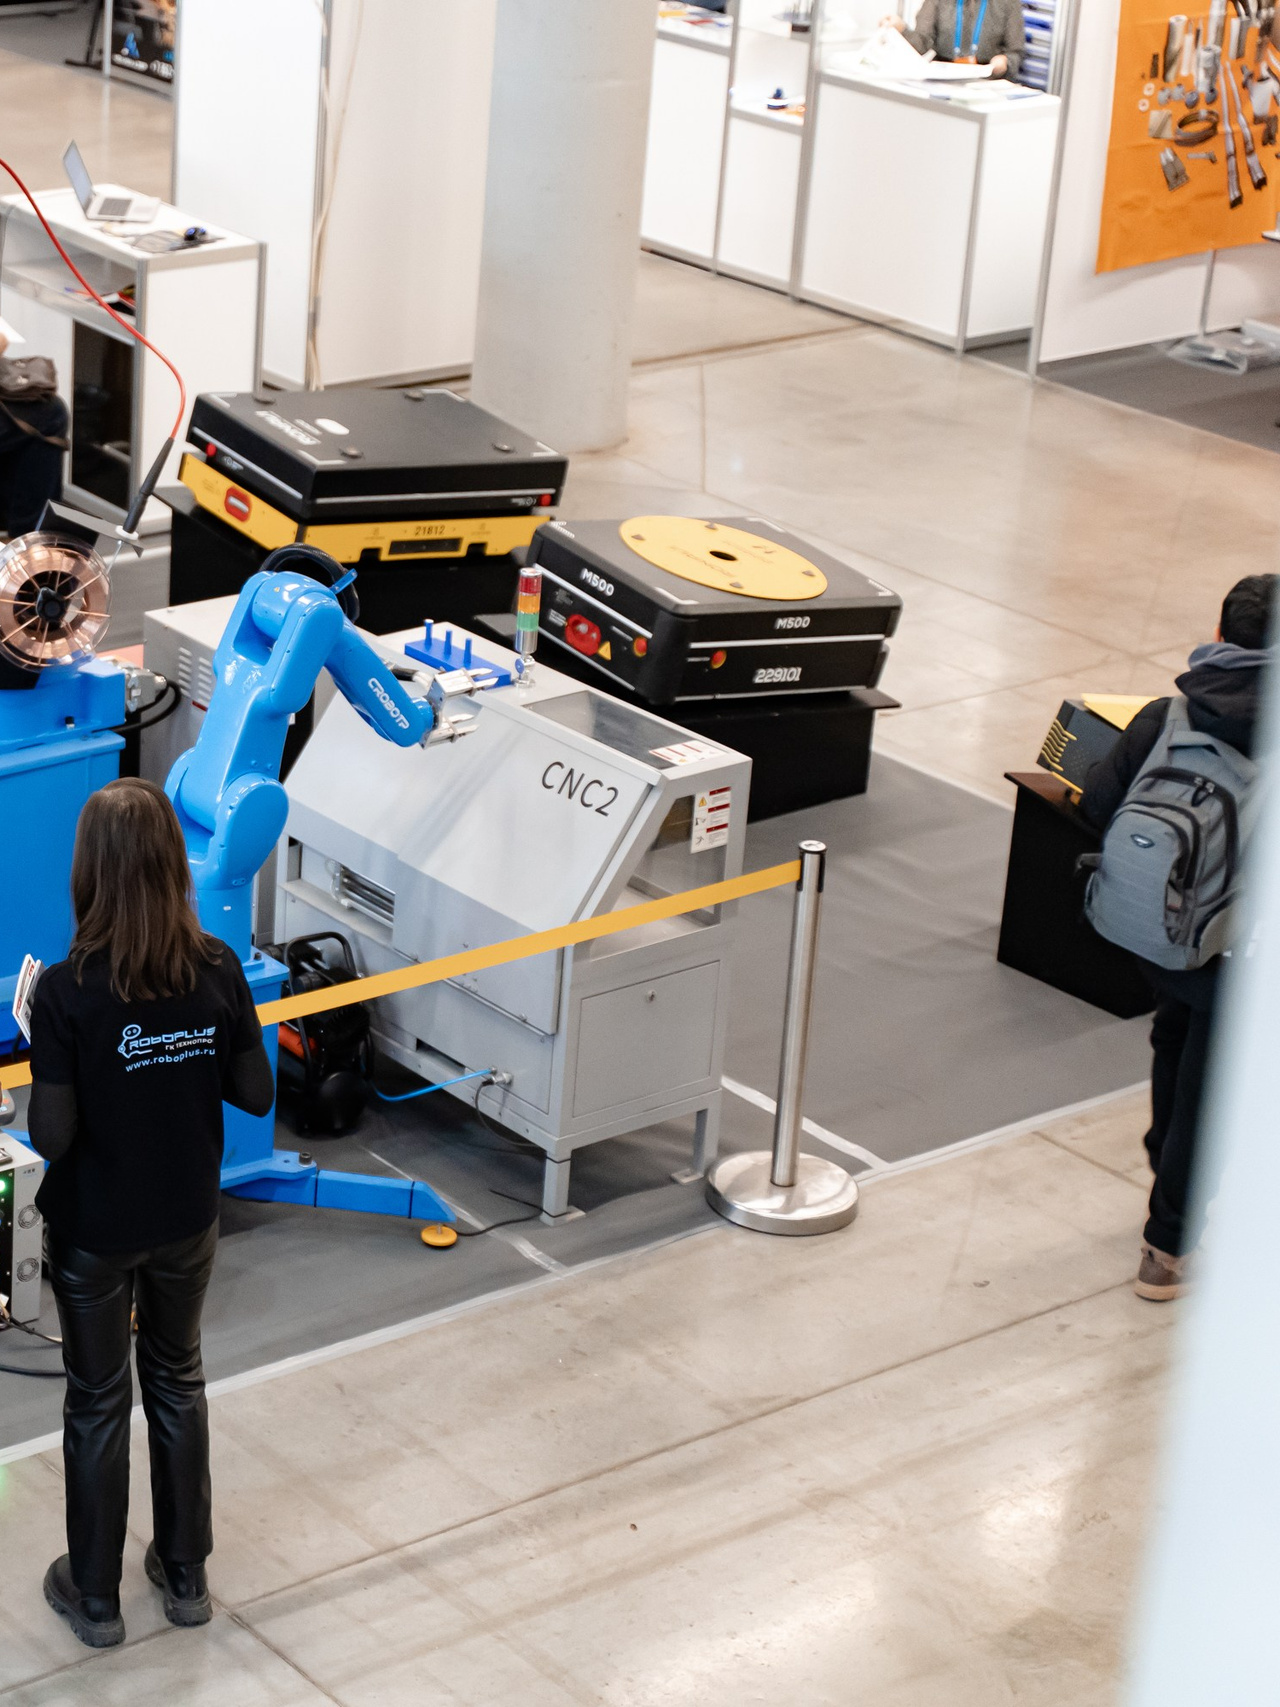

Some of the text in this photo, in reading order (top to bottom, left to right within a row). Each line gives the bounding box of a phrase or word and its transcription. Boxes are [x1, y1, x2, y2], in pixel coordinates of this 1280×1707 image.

[414, 525, 446, 537] 21812
[581, 567, 615, 597] M500
[775, 615, 811, 630] M500
[753, 666, 802, 684] 229101
[541, 761, 619, 817] CNC2
[125, 1048, 216, 1073] www.roboplus.ru
